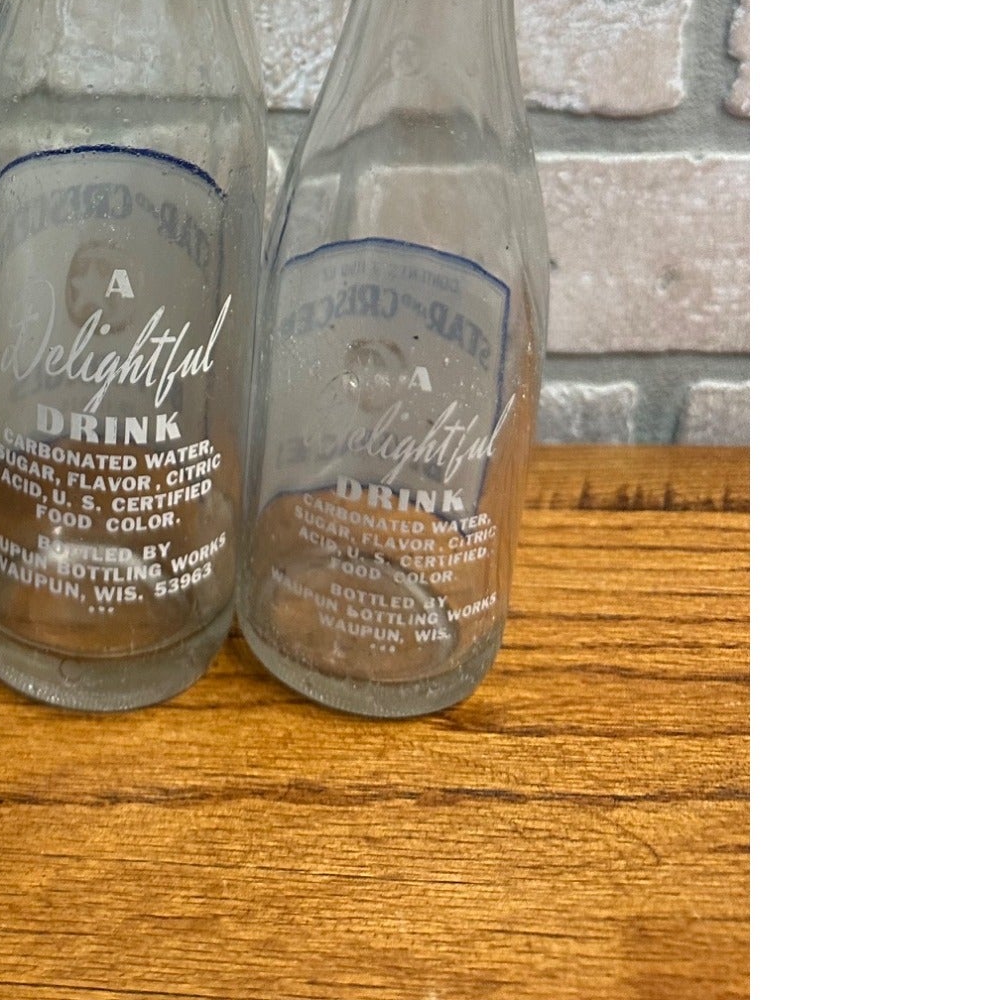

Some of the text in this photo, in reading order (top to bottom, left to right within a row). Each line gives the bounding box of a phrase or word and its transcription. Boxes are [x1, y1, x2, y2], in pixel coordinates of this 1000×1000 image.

[105, 269, 135, 298] A
[1, 280, 232, 412] Delightful
[408, 366, 432, 392] A
[36, 403, 181, 445] DRINK
[344, 393, 516, 485] elightful
[3, 427, 214, 470] CARBONATED WATER,
[166, 452, 222, 486] CITRIC
[111, 478, 212, 513] CERTIFIED
[335, 475, 465, 512] DRINK
[35, 504, 180, 532] FOOD COLOR.
[303, 493, 491, 534] CARBONATED WATER,
[143, 541, 172, 560] BY
[448, 525, 497, 549] CITRIC
[57, 561, 162, 583] BOTTLING
[171, 531, 227, 574] WORKS
[328, 558, 382, 580] FOOD
[94, 585, 144, 603] WIS.
[154, 561, 213, 598] 53963
[271, 566, 338, 612] WAUPUN
[447, 592, 497, 622] WORKS
[330, 583, 448, 609] BOTTLED BY
[319, 611, 404, 644] WAUPUN,
